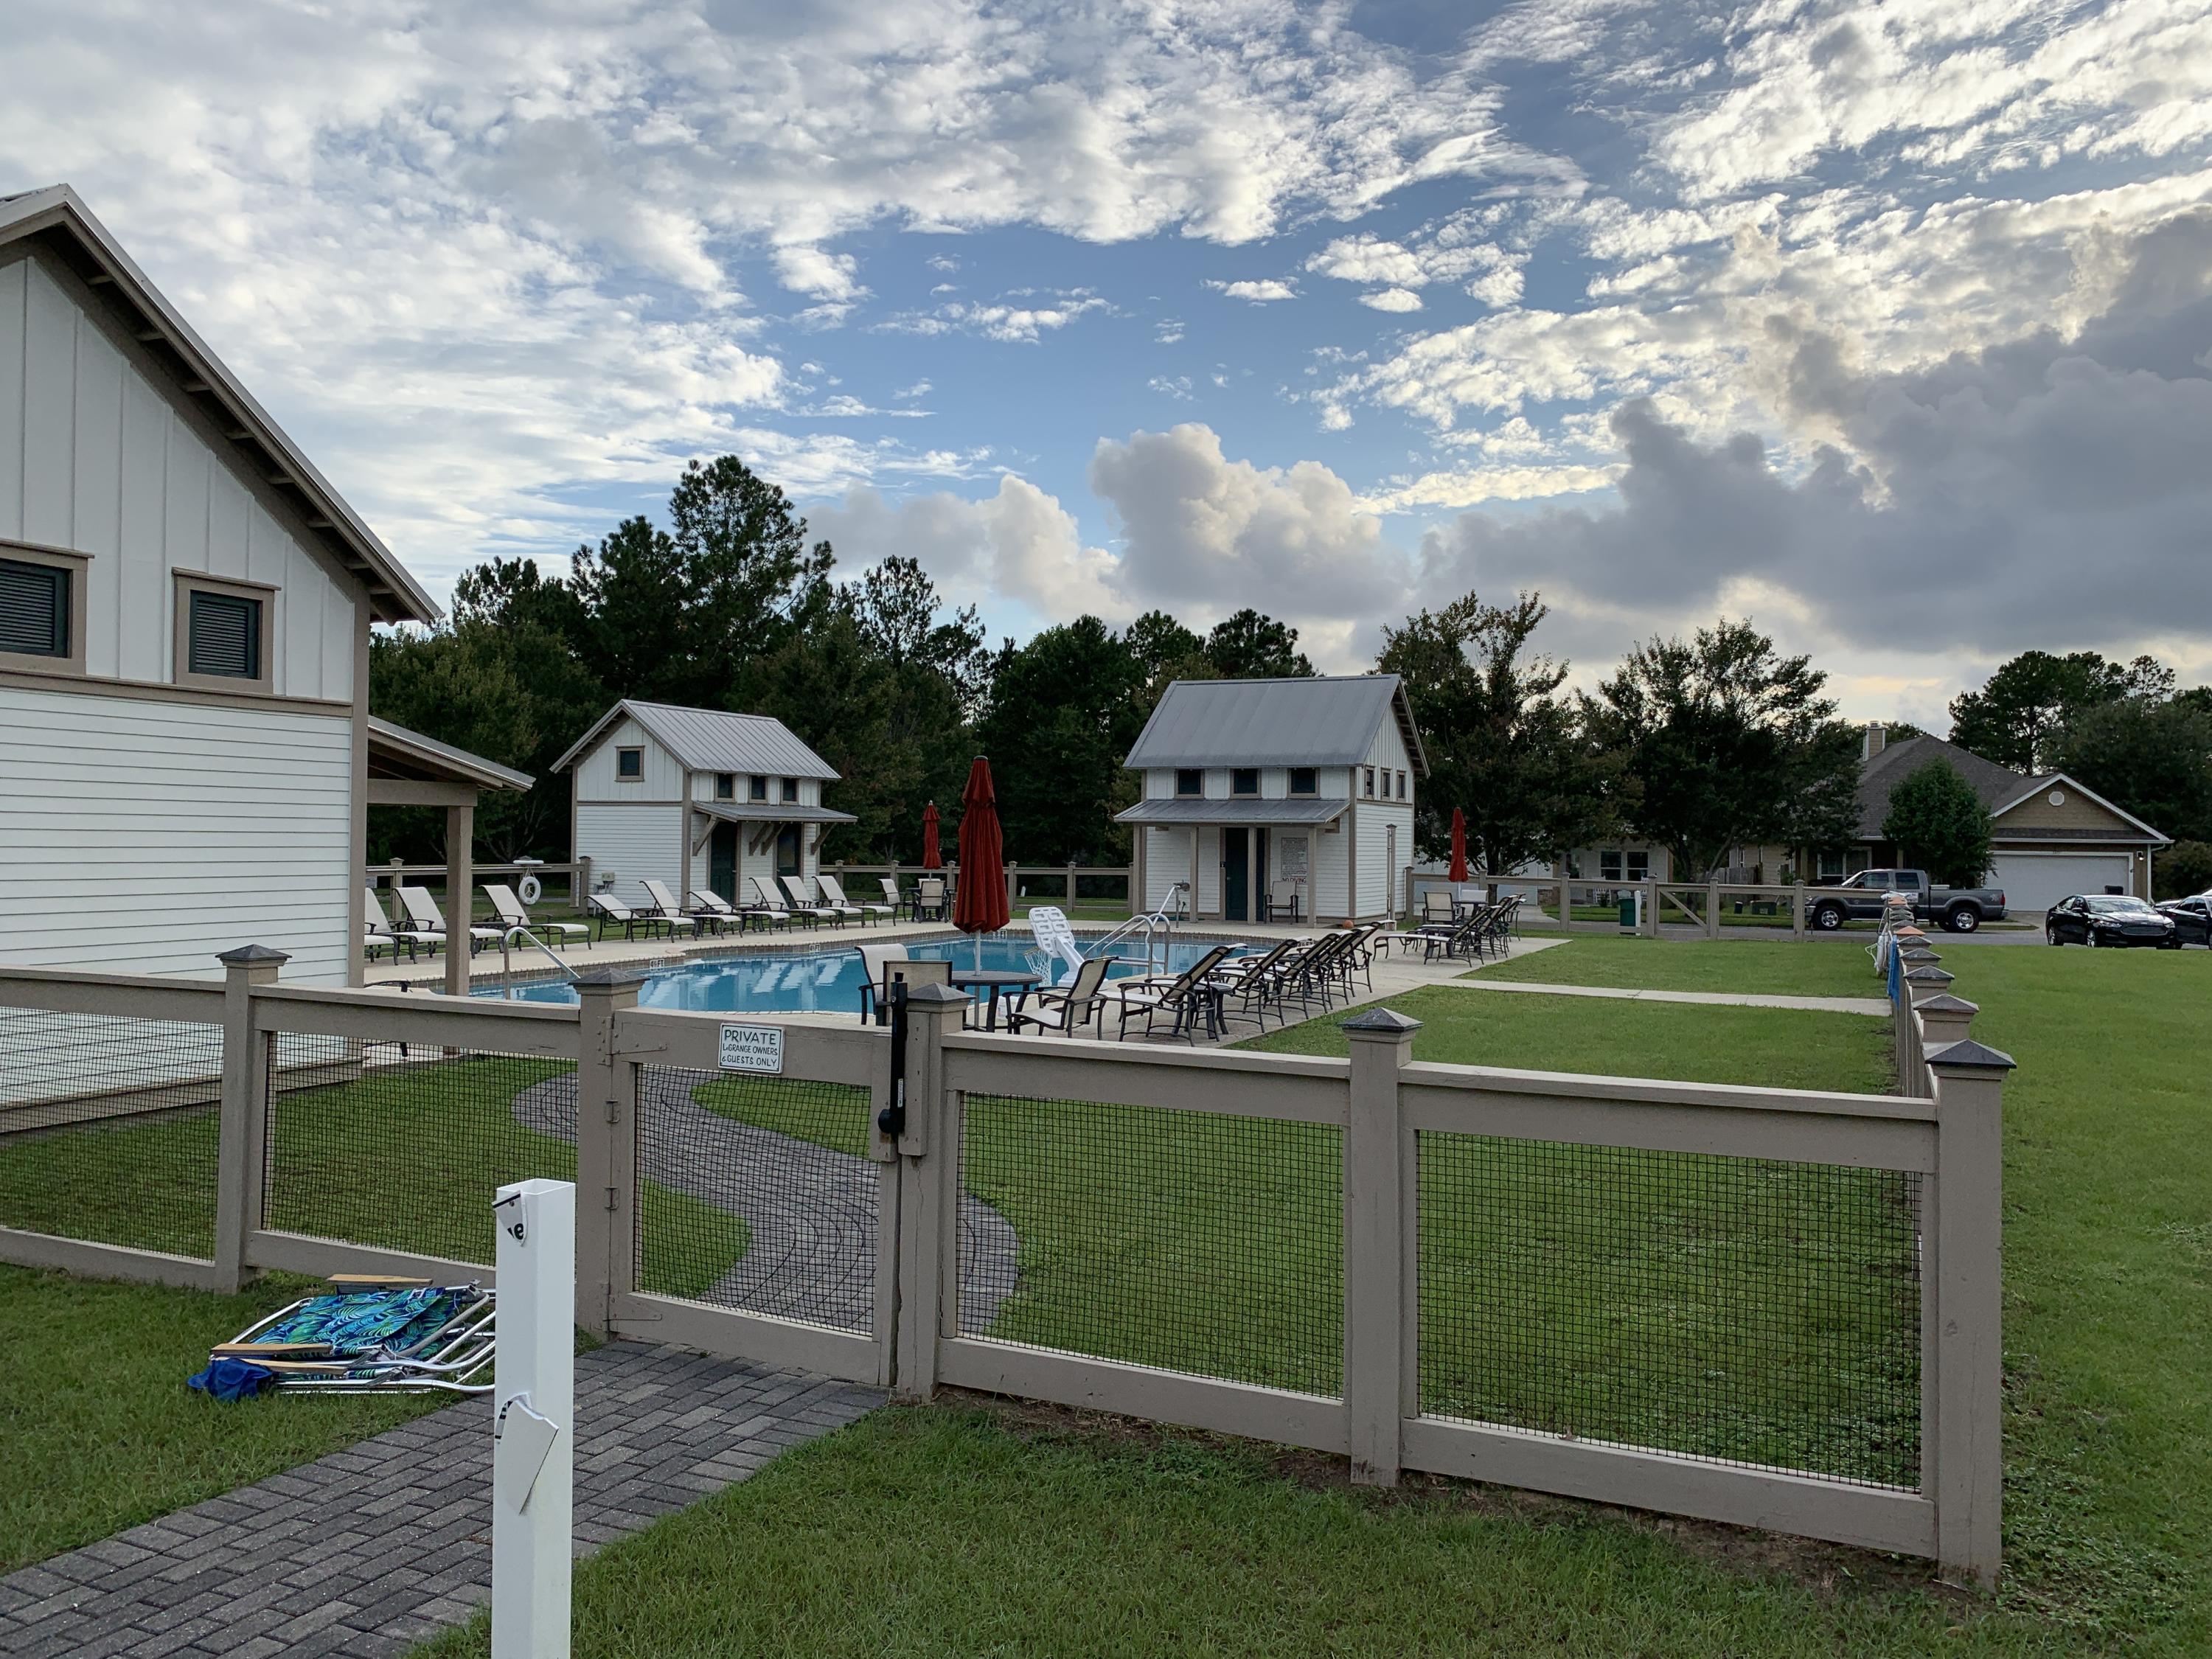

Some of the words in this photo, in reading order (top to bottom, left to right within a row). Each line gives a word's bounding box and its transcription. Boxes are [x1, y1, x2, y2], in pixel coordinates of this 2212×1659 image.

[724, 1029, 776, 1045] PRIVATE
[752, 1046, 778, 1056] OWNERS
[727, 1054, 754, 1065] GUESTS
[756, 1057, 777, 1066] ONLY
